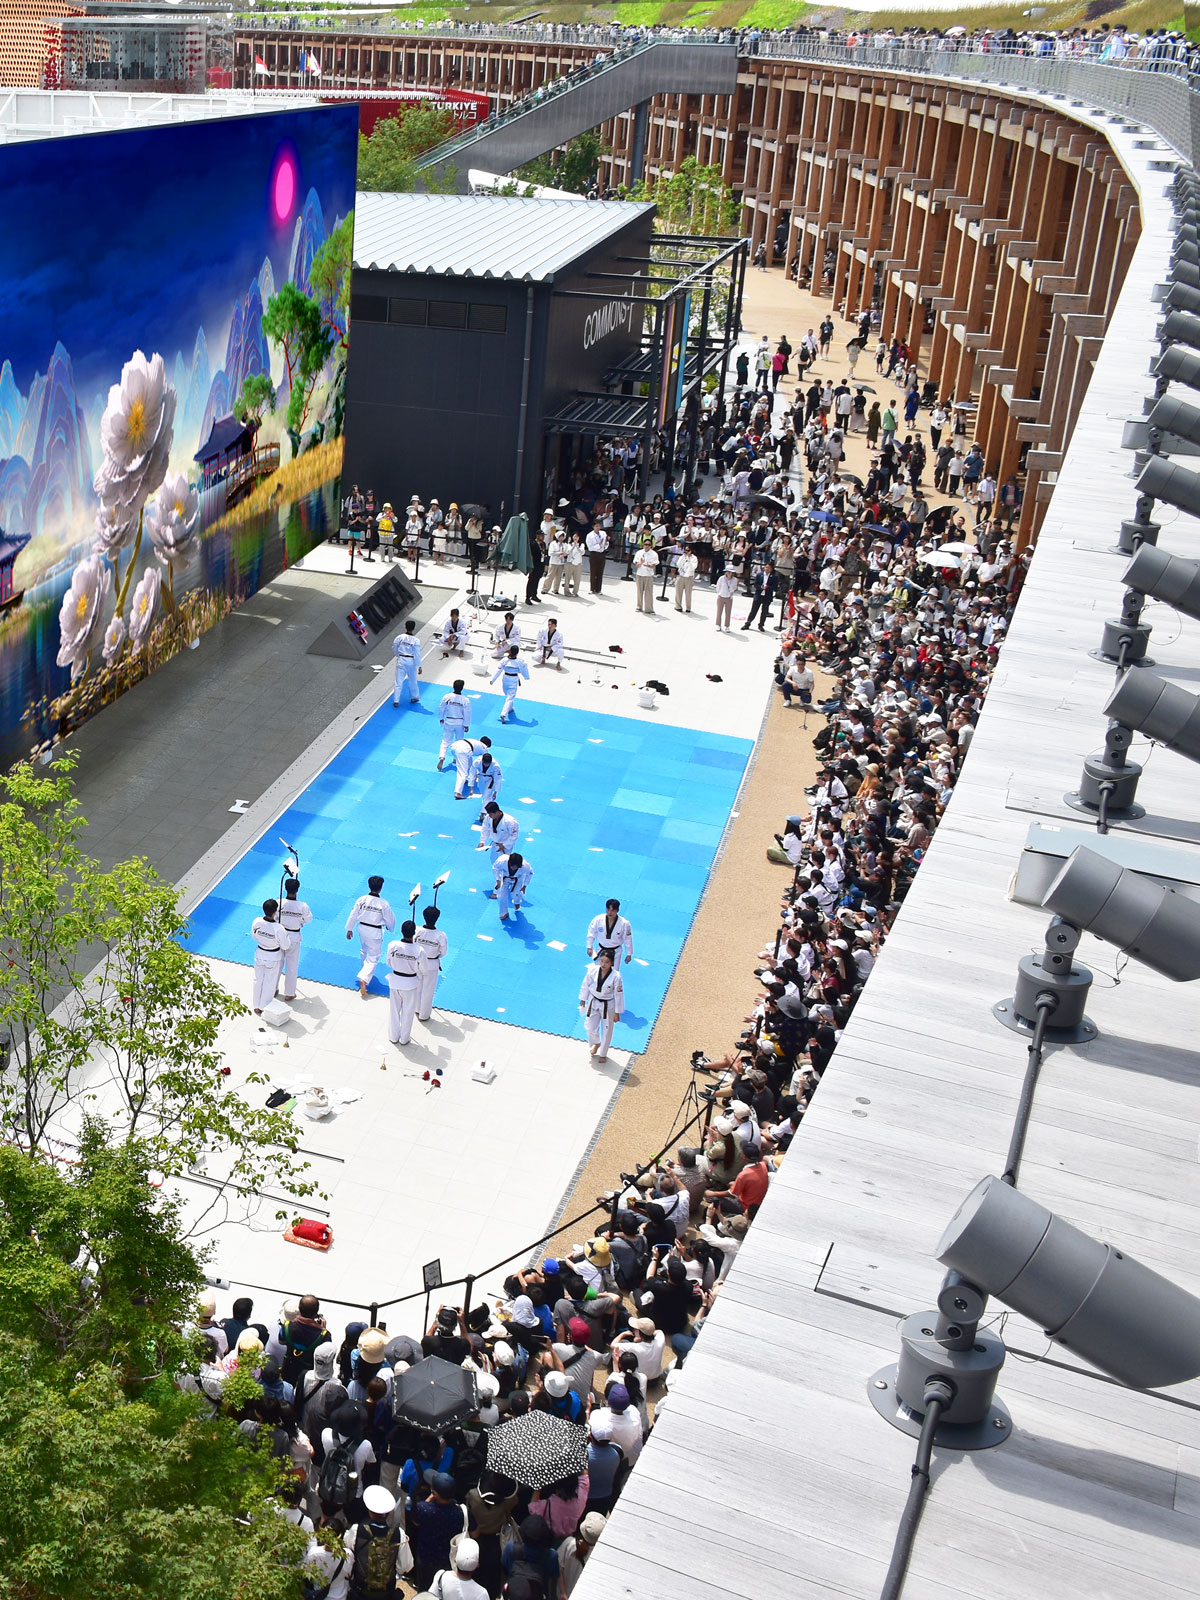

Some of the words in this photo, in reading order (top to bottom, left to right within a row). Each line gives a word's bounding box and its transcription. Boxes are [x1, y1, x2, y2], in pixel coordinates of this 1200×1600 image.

[453, 110, 477, 120] トルコ
[356, 575, 415, 635] KOREA
